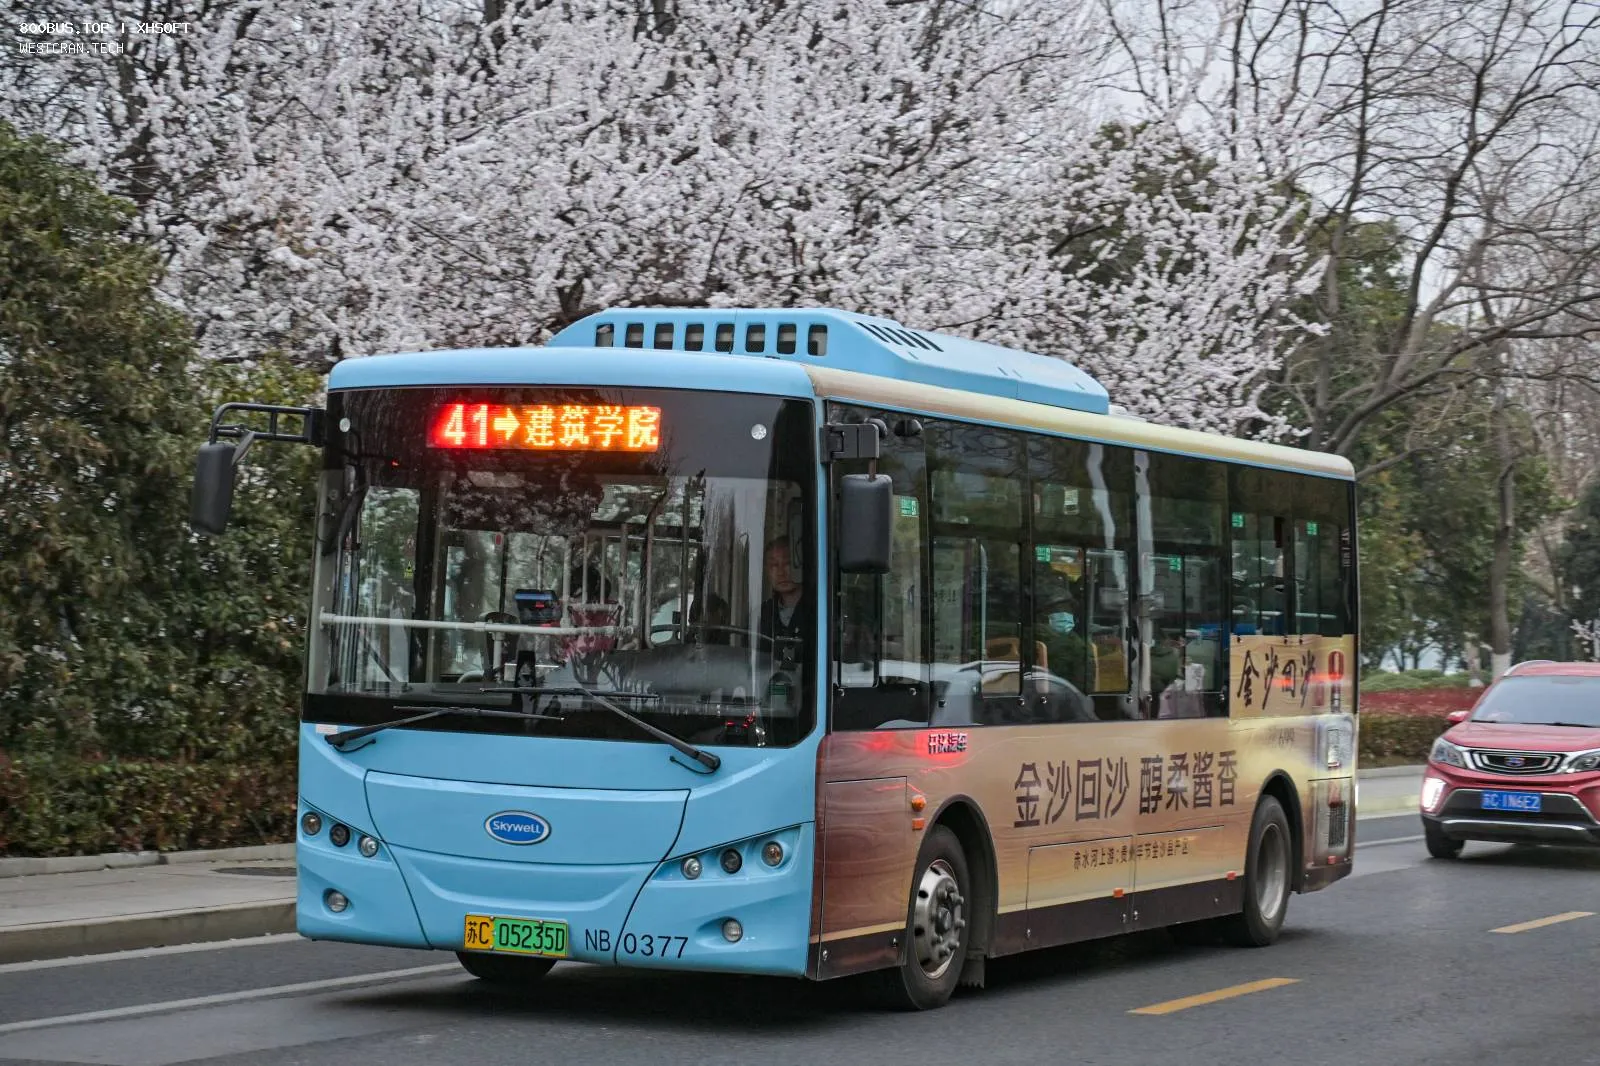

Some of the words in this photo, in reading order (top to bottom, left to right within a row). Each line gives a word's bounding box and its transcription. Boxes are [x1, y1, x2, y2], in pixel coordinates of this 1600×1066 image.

[443, 403, 489, 446] 41
[524, 404, 660, 448] 建筑学院
[1013, 757, 1131, 829] 金沙回沙
[1139, 750, 1239, 815] 醇柔酱香
[492, 820, 541, 835] Skywell
[585, 928, 611, 951] NB
[623, 932, 690, 959] 0377
